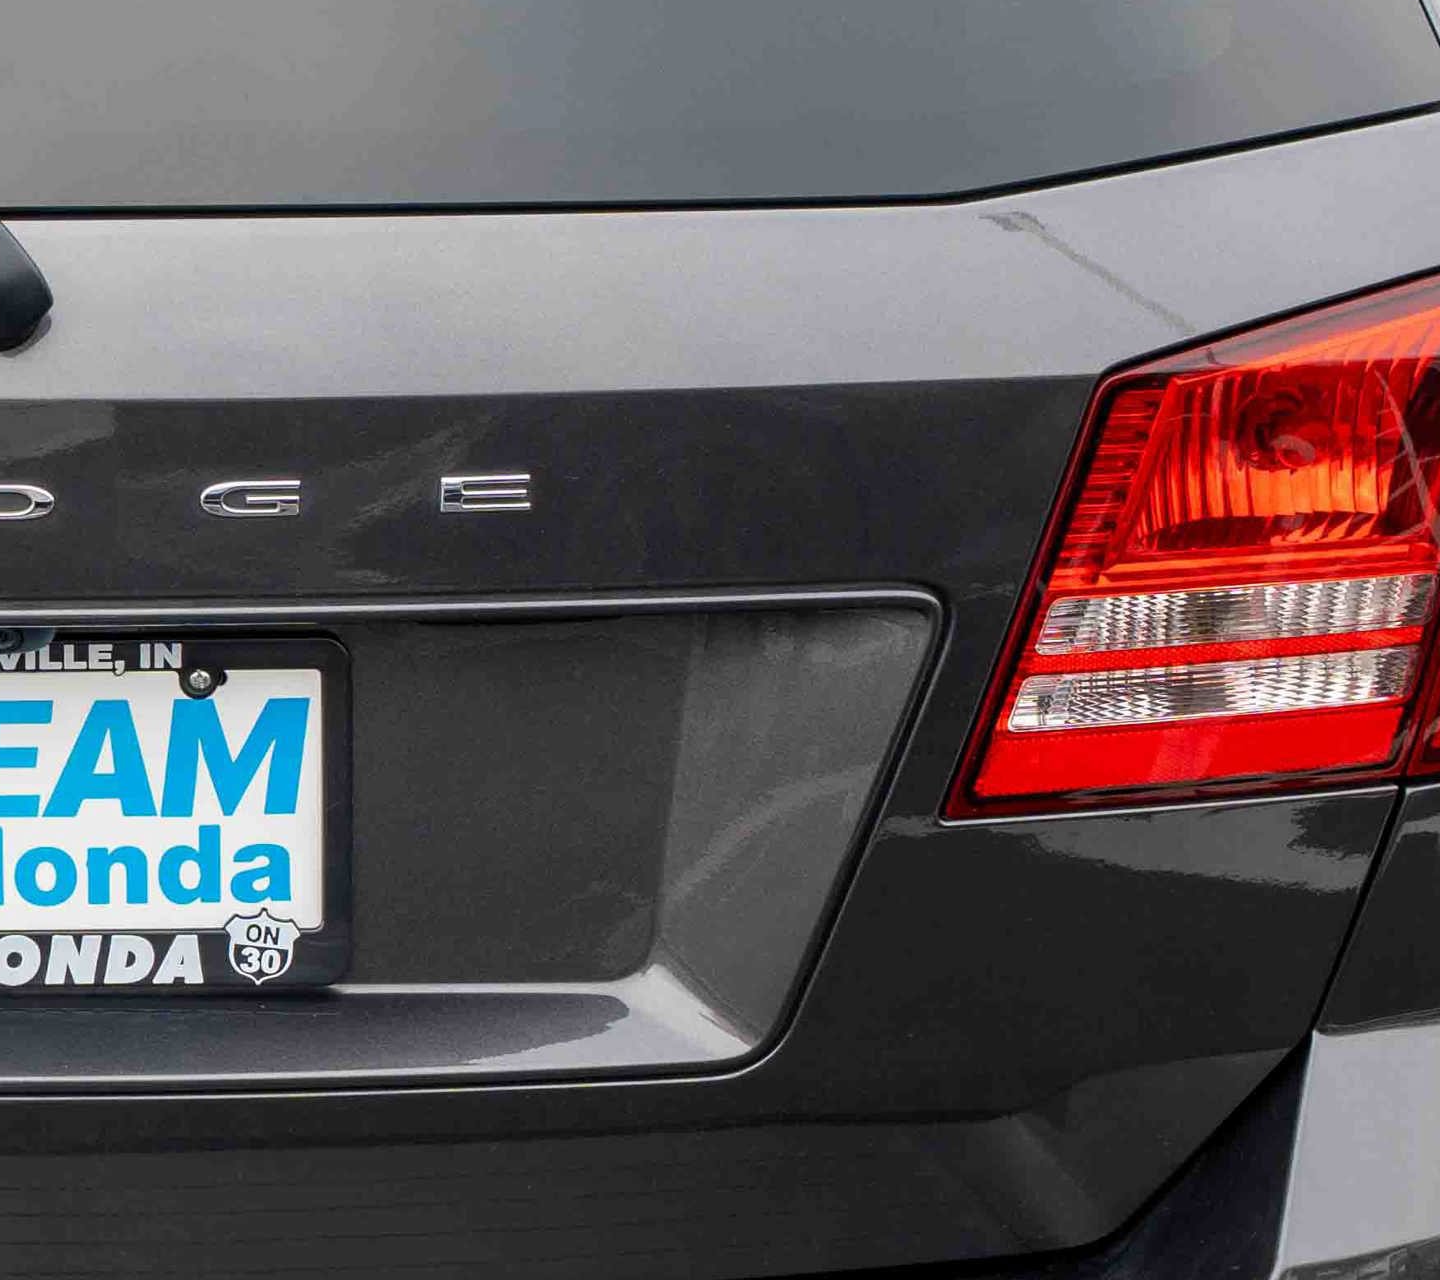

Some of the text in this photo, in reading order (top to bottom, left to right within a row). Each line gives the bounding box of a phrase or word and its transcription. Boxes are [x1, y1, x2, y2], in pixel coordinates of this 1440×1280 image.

[139, 642, 182, 670] IN
[246, 924, 280, 945] ON
[239, 946, 281, 974] 30
